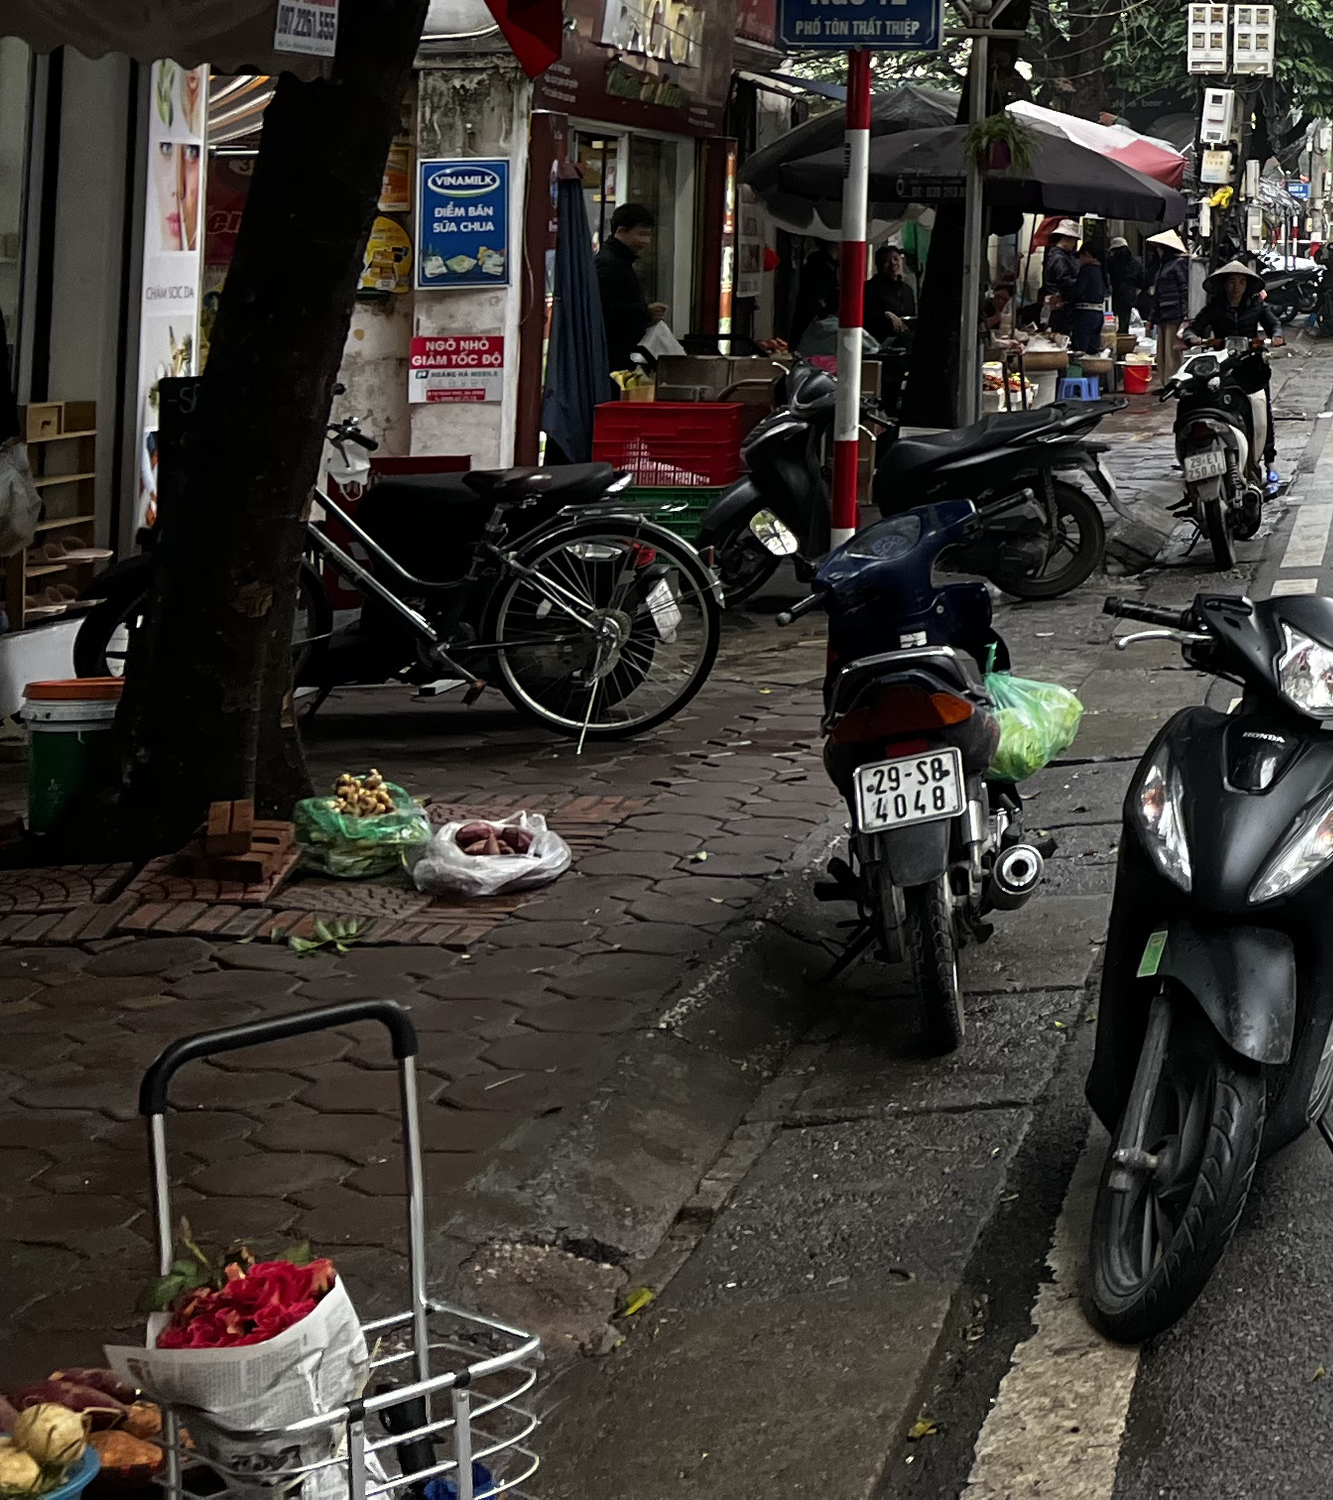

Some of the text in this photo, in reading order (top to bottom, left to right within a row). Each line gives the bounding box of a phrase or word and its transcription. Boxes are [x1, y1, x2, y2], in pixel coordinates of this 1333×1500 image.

[795, 15, 921, 39] PHỐ TÔN THẤT THIỆP
[434, 174, 493, 186] VINAMILK
[434, 201, 493, 217] ĐIỂM BÁN
[432, 219, 494, 233] SỮA CHUA
[425, 337, 457, 351] NGÕ
[411, 350, 502, 367] GIẢM TỐC ĐỘ
[873, 757, 943, 795] 29-S8
[876, 785, 945, 823] 4048
